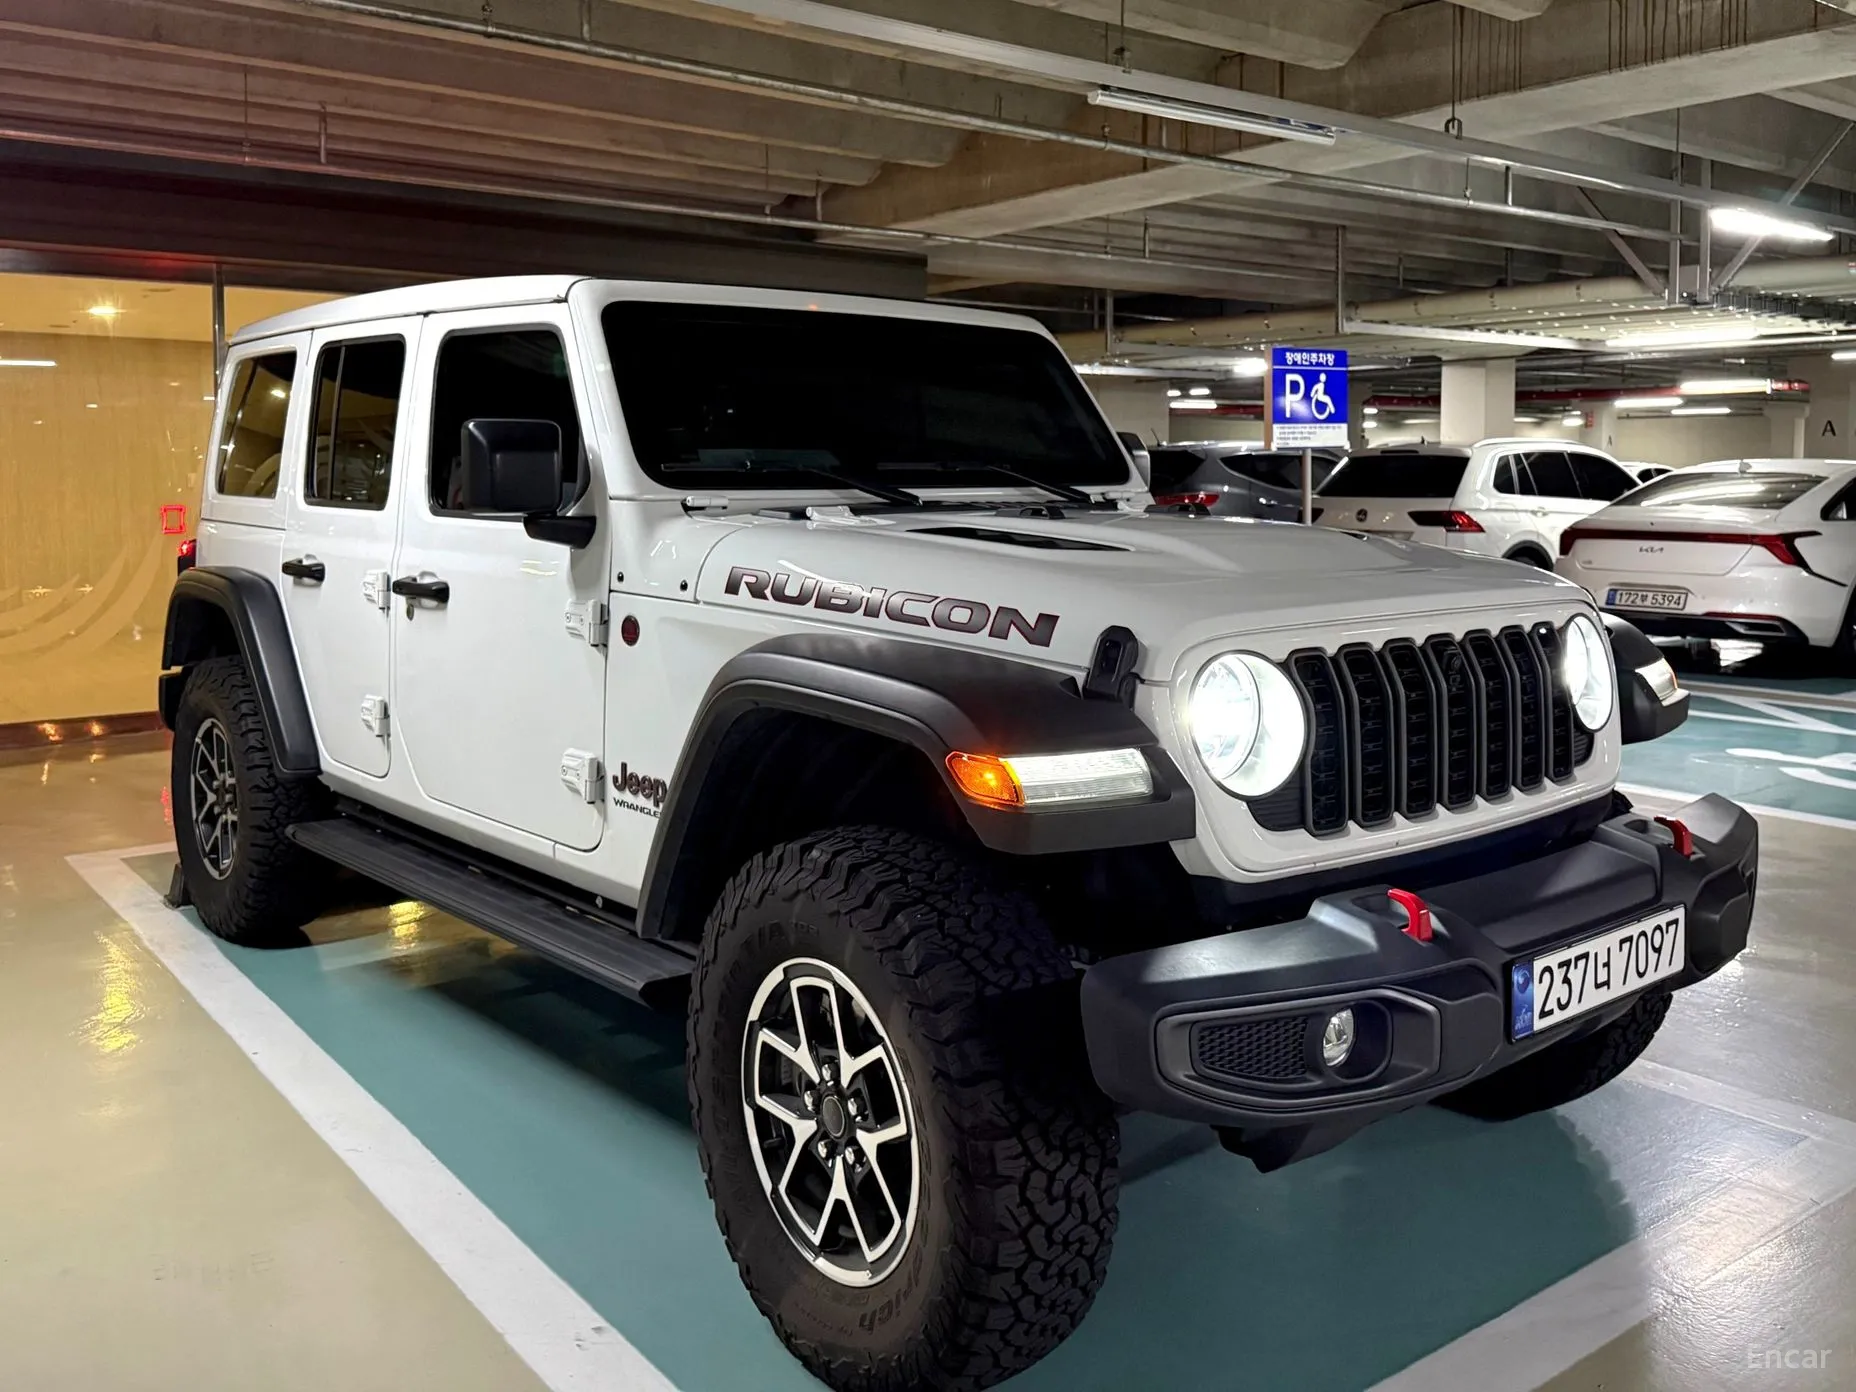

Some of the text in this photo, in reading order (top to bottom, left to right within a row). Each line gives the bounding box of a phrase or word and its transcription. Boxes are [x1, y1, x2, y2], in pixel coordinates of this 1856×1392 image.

[1285, 351, 1335, 366] 장애인주차장
[1285, 373, 1305, 418] P
[1822, 420, 1837, 436] A
[724, 566, 1060, 648] RUBICON
[1650, 593, 1682, 607] 5394
[612, 761, 668, 808] Jeep
[613, 797, 662, 819] WRANGLE
[1538, 917, 1680, 1020] 237너 7097
